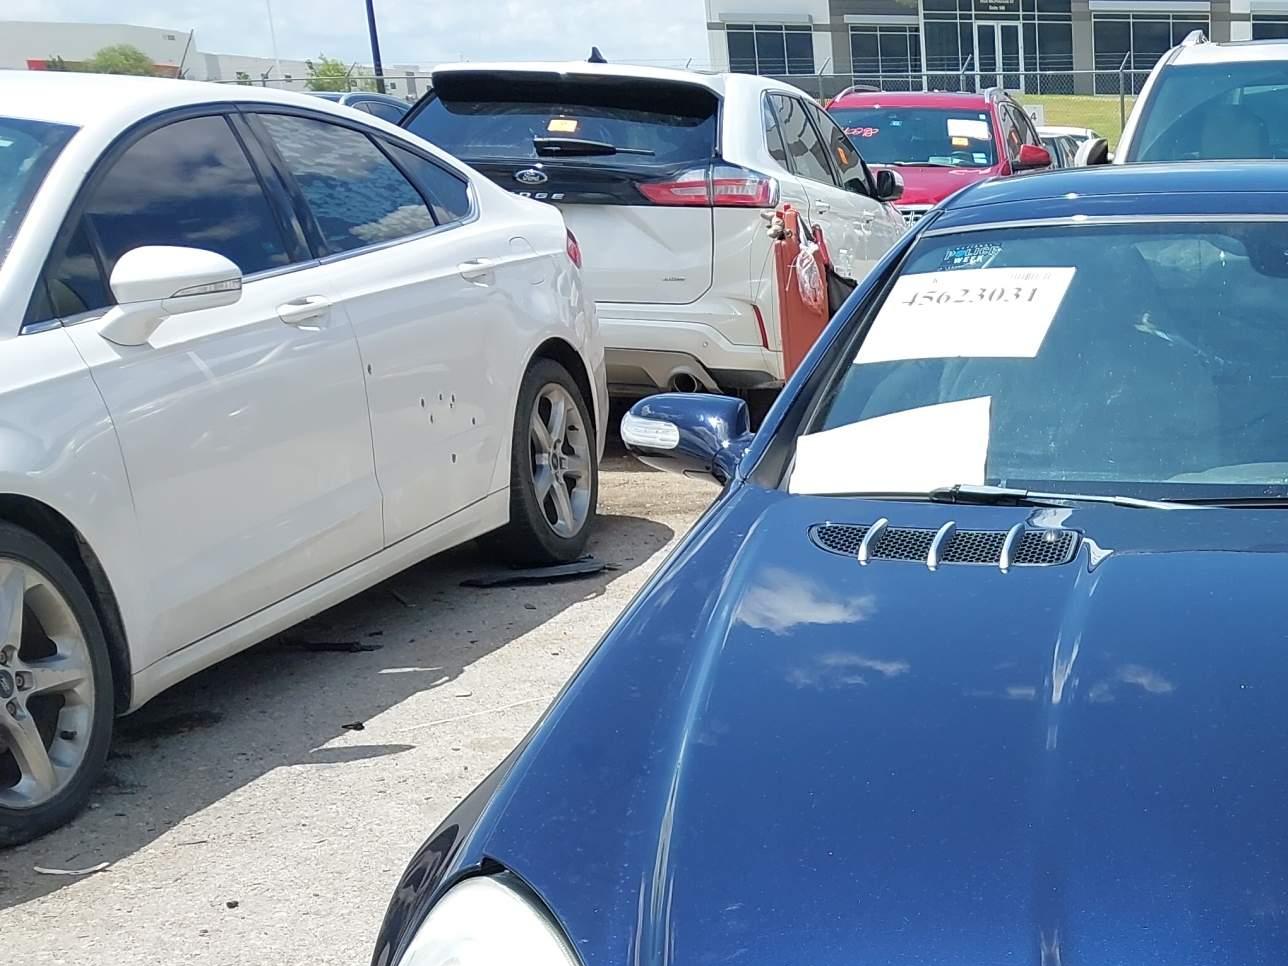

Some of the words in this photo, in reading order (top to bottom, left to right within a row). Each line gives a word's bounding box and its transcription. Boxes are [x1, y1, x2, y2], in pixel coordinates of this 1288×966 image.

[944, 245, 1003, 261] POLICE
[953, 255, 984, 264] WEEK
[902, 287, 1038, 306] 45623031
